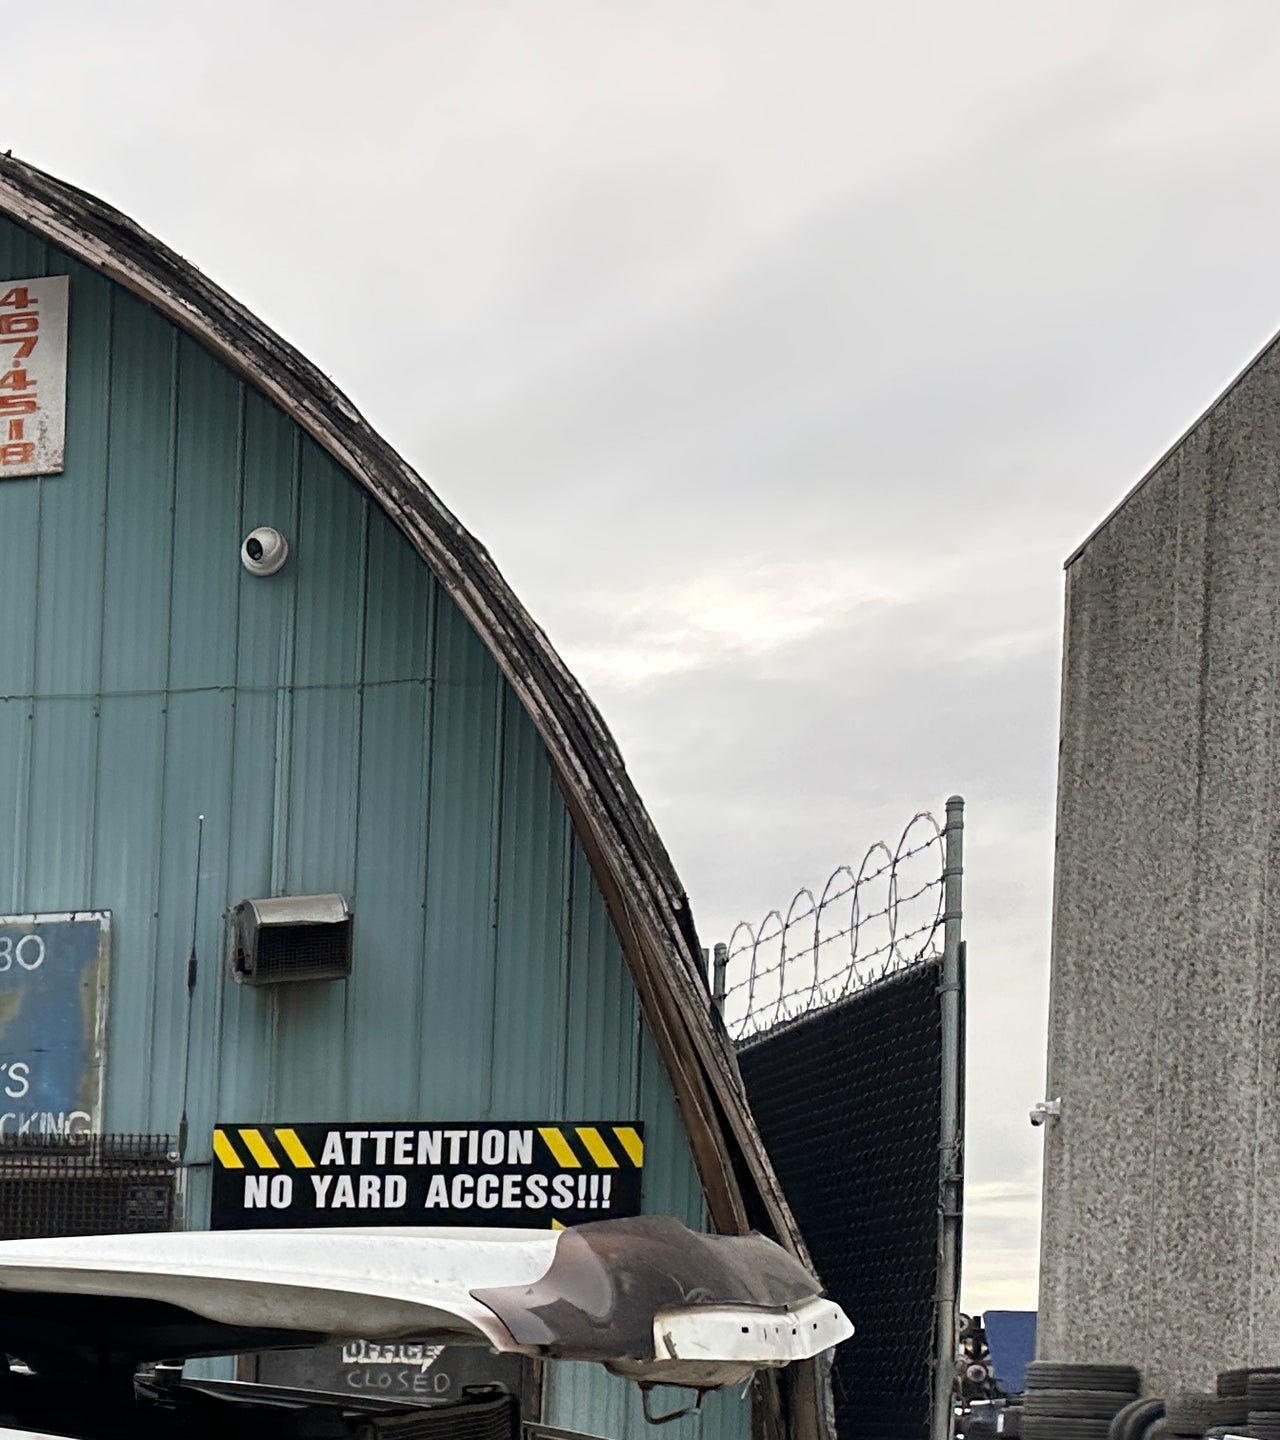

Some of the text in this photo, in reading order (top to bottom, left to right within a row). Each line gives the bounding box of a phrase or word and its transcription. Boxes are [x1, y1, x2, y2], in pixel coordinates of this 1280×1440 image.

[319, 1129, 534, 1166] ATTENTION
[243, 1173, 612, 1209] NO YARD ACCESS!!!
[347, 1367, 451, 1393] CLOSED
